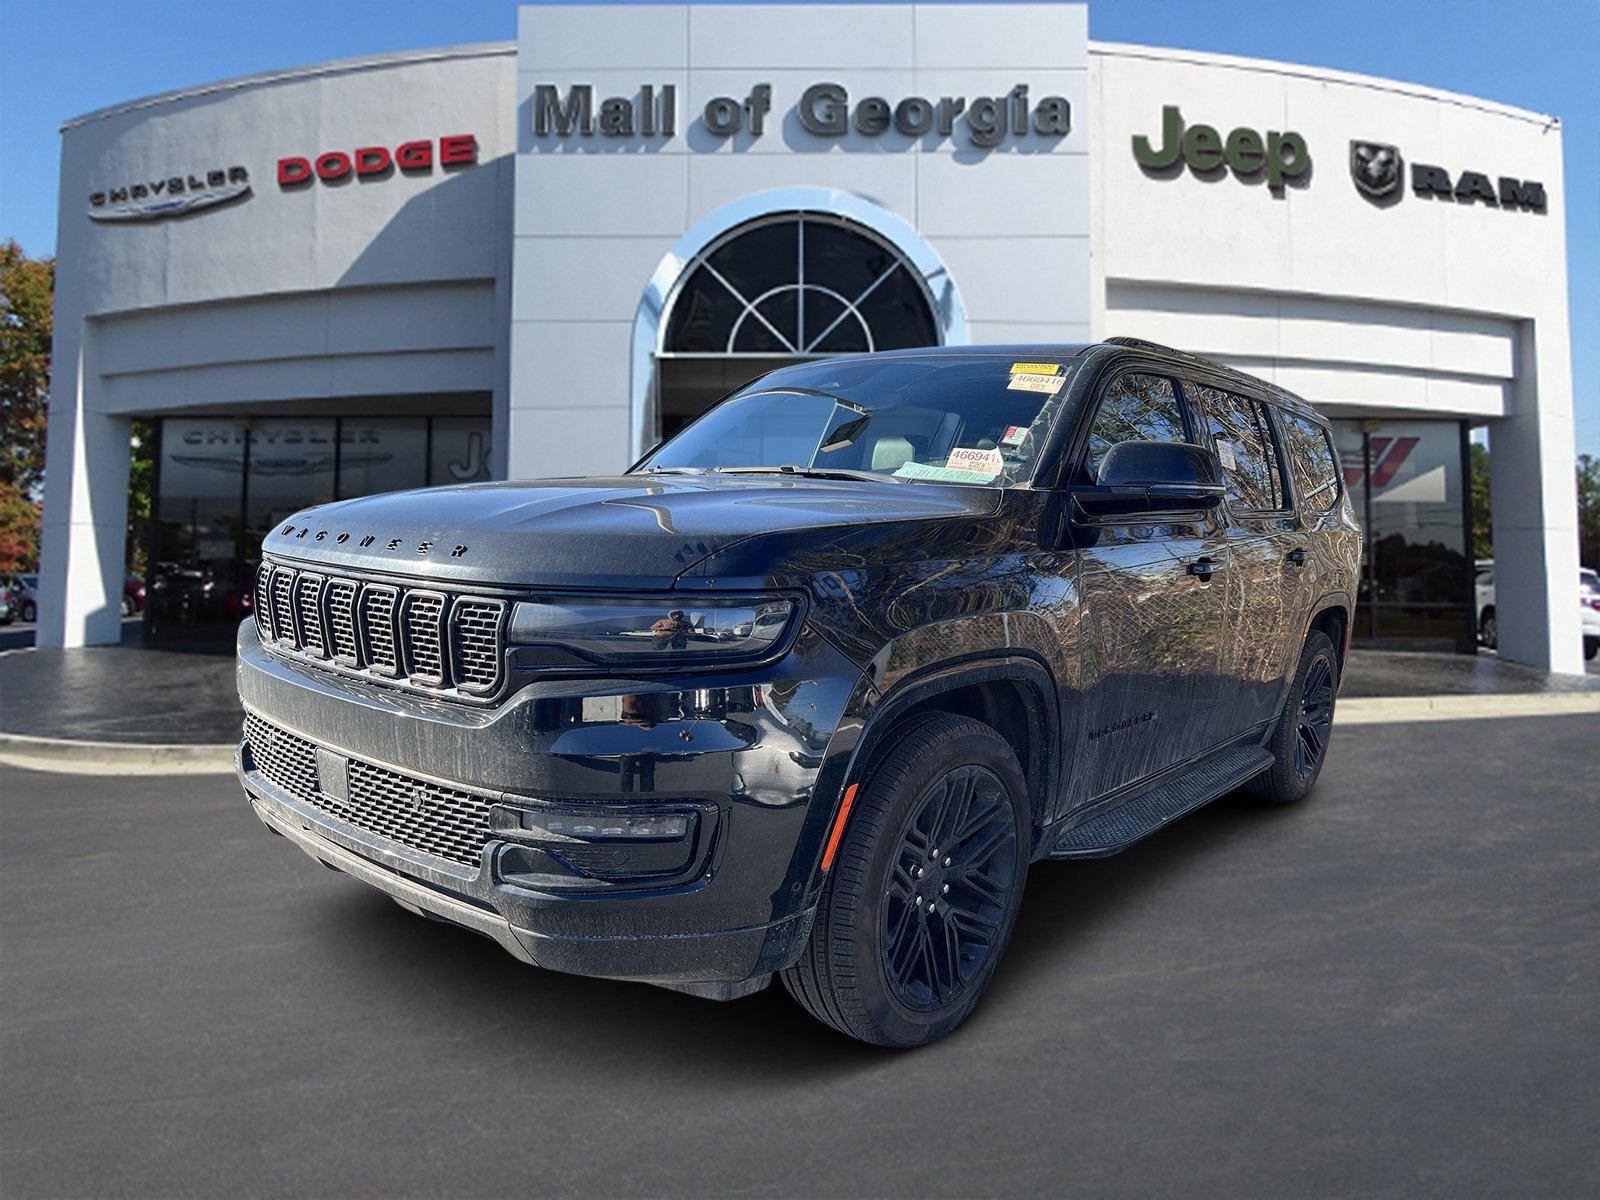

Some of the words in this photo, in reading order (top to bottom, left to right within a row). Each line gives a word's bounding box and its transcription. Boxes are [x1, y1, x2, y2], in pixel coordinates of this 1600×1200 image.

[532, 84, 676, 137] Mall
[703, 83, 772, 137] of
[799, 83, 1073, 148] Georgia
[277, 134, 477, 189] DODGE
[1131, 105, 1310, 194] Jeep
[89, 165, 249, 206] CHRYSLER
[1411, 163, 1547, 213] RAM
[281, 524, 468, 558] WAGONEER
